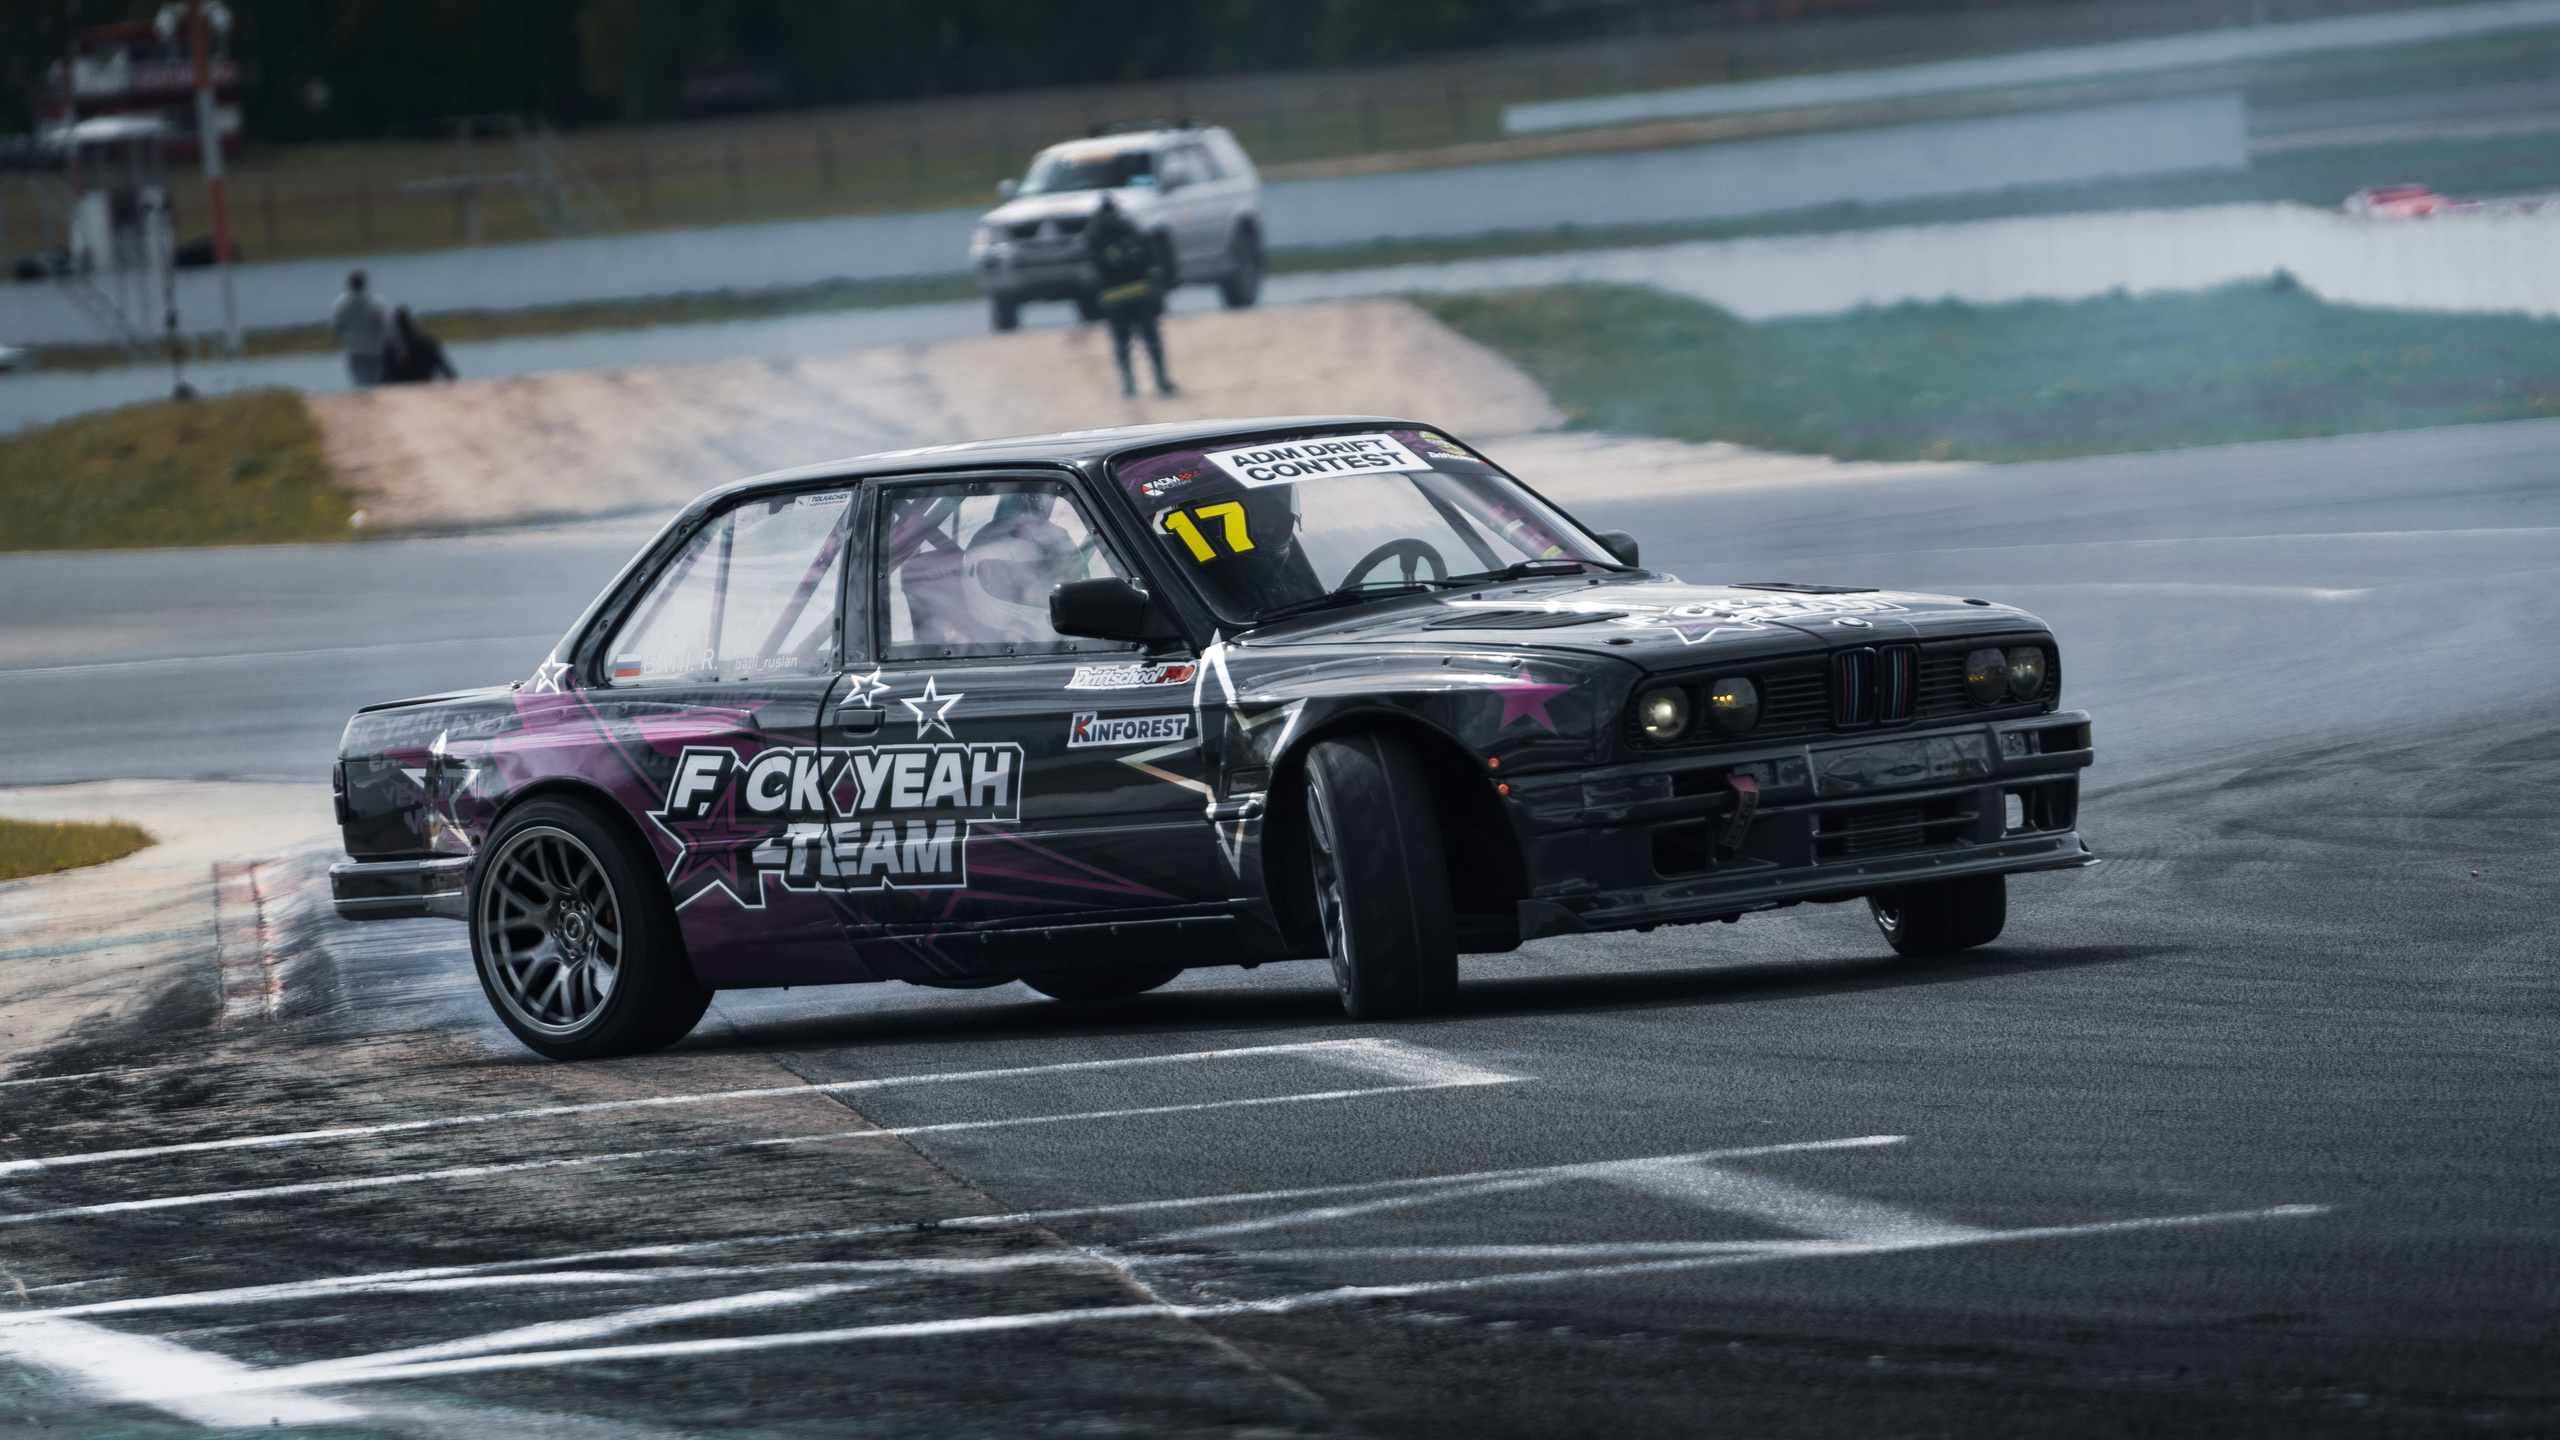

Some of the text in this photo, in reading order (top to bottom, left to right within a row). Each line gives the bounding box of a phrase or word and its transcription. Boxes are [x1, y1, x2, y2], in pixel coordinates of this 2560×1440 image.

[1231, 439, 1389, 467] ADM DRIFT
[1246, 452, 1408, 481] CONTEST
[1153, 476, 1180, 487] ADM
[812, 493, 850, 502] TOLKACHEV
[1164, 501, 1255, 563] 17
[1072, 714, 1188, 743] KINFOREST
[859, 751, 1013, 809] YEAH
